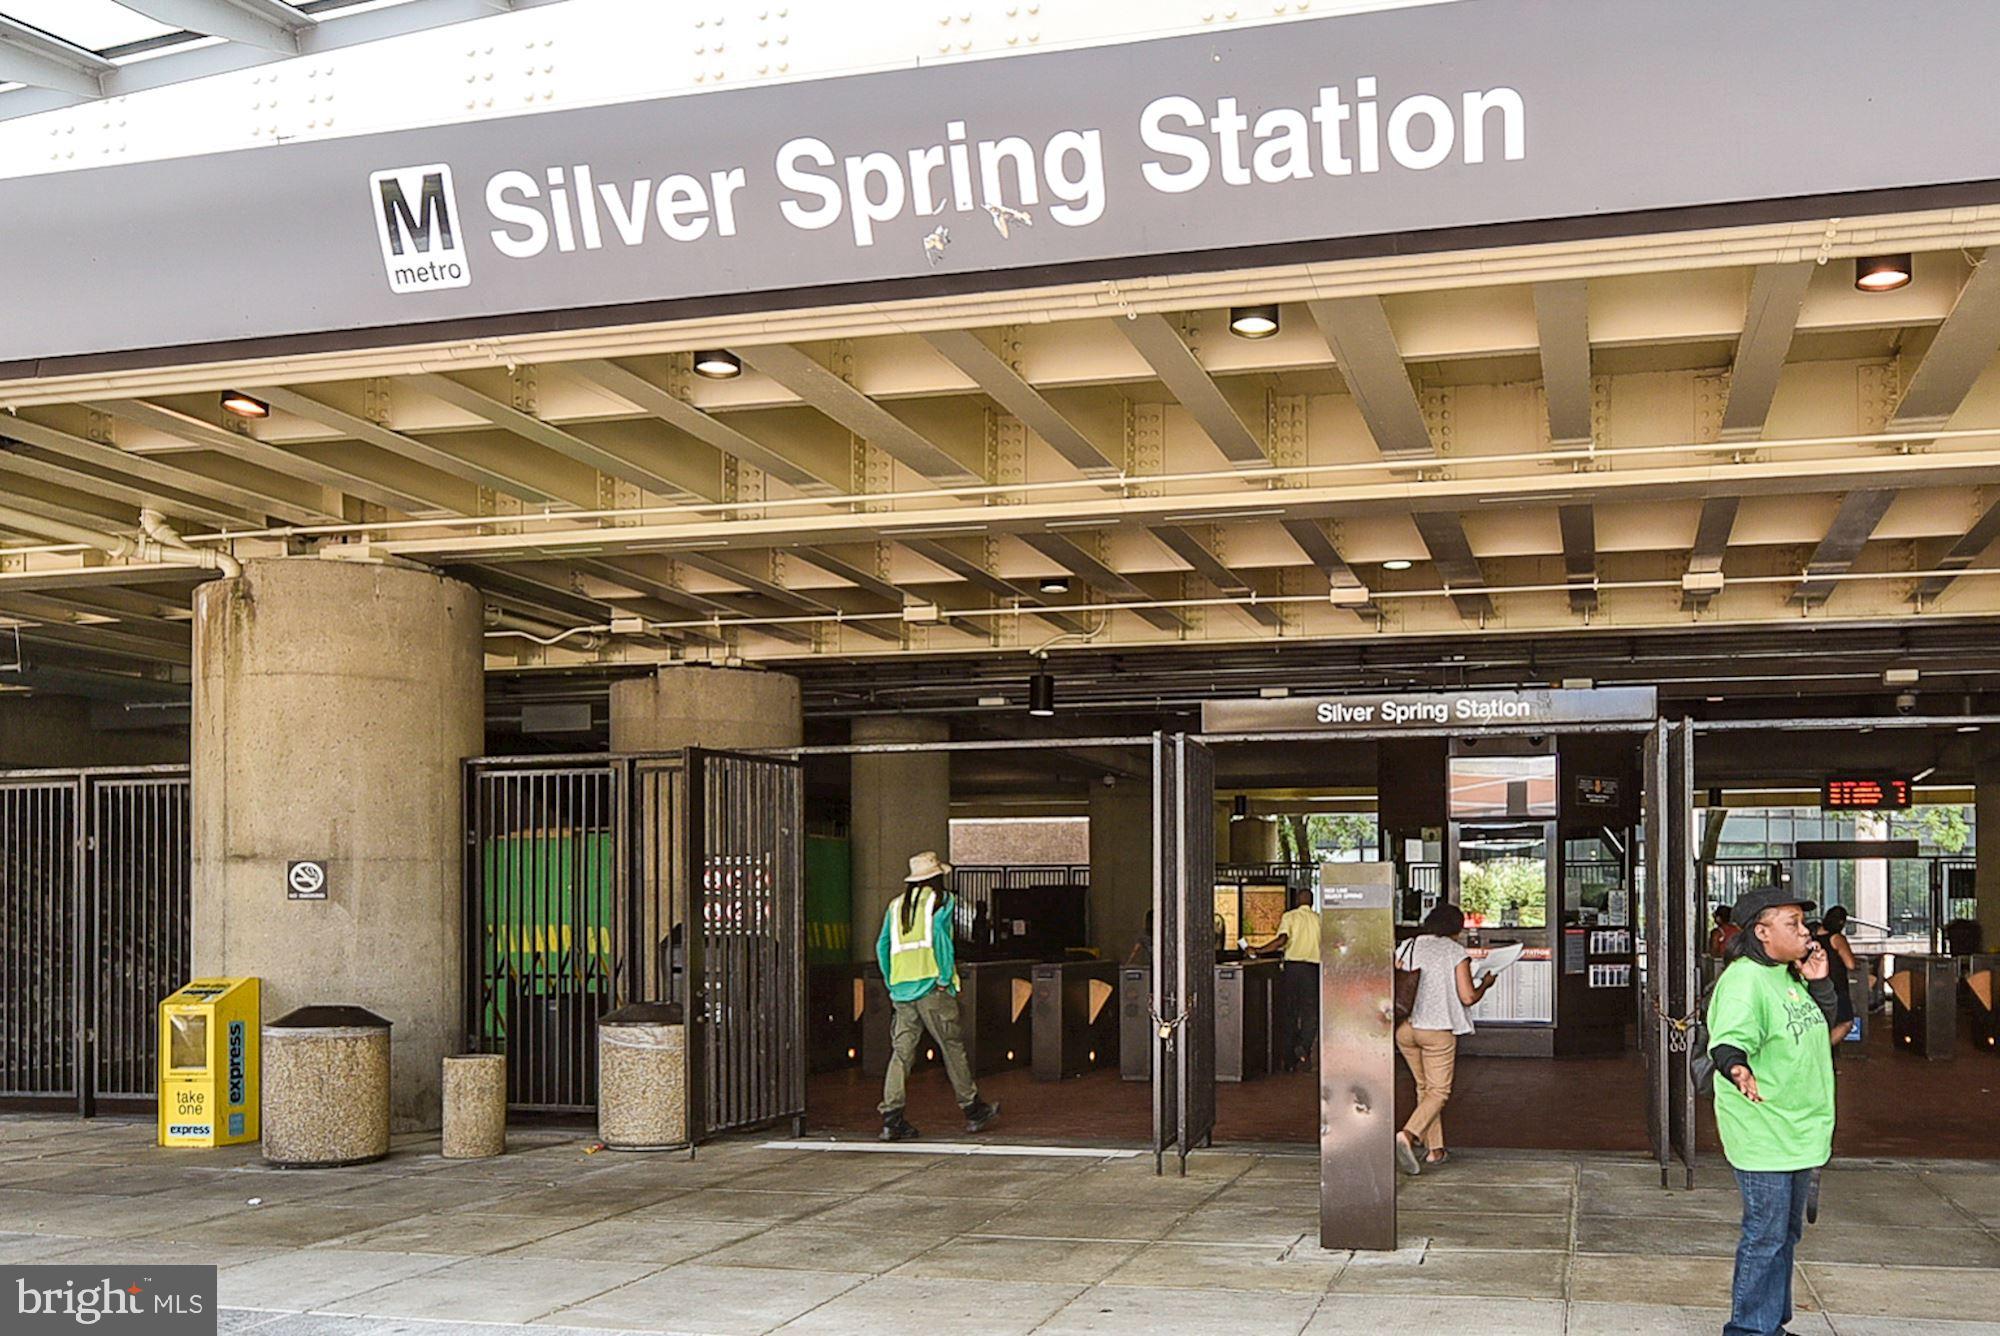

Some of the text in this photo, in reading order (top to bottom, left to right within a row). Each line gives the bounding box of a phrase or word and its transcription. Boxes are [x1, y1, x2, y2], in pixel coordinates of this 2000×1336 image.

[486, 76, 1526, 259] Silver Spring Station
[379, 172, 454, 256] M
[395, 261, 461, 284] metro
[1317, 699, 1530, 724] Silver Spring Station
[229, 1023, 244, 1104] express
[176, 1090, 204, 1104] take
[178, 1104, 203, 1115] one
[170, 1125, 210, 1136] express
